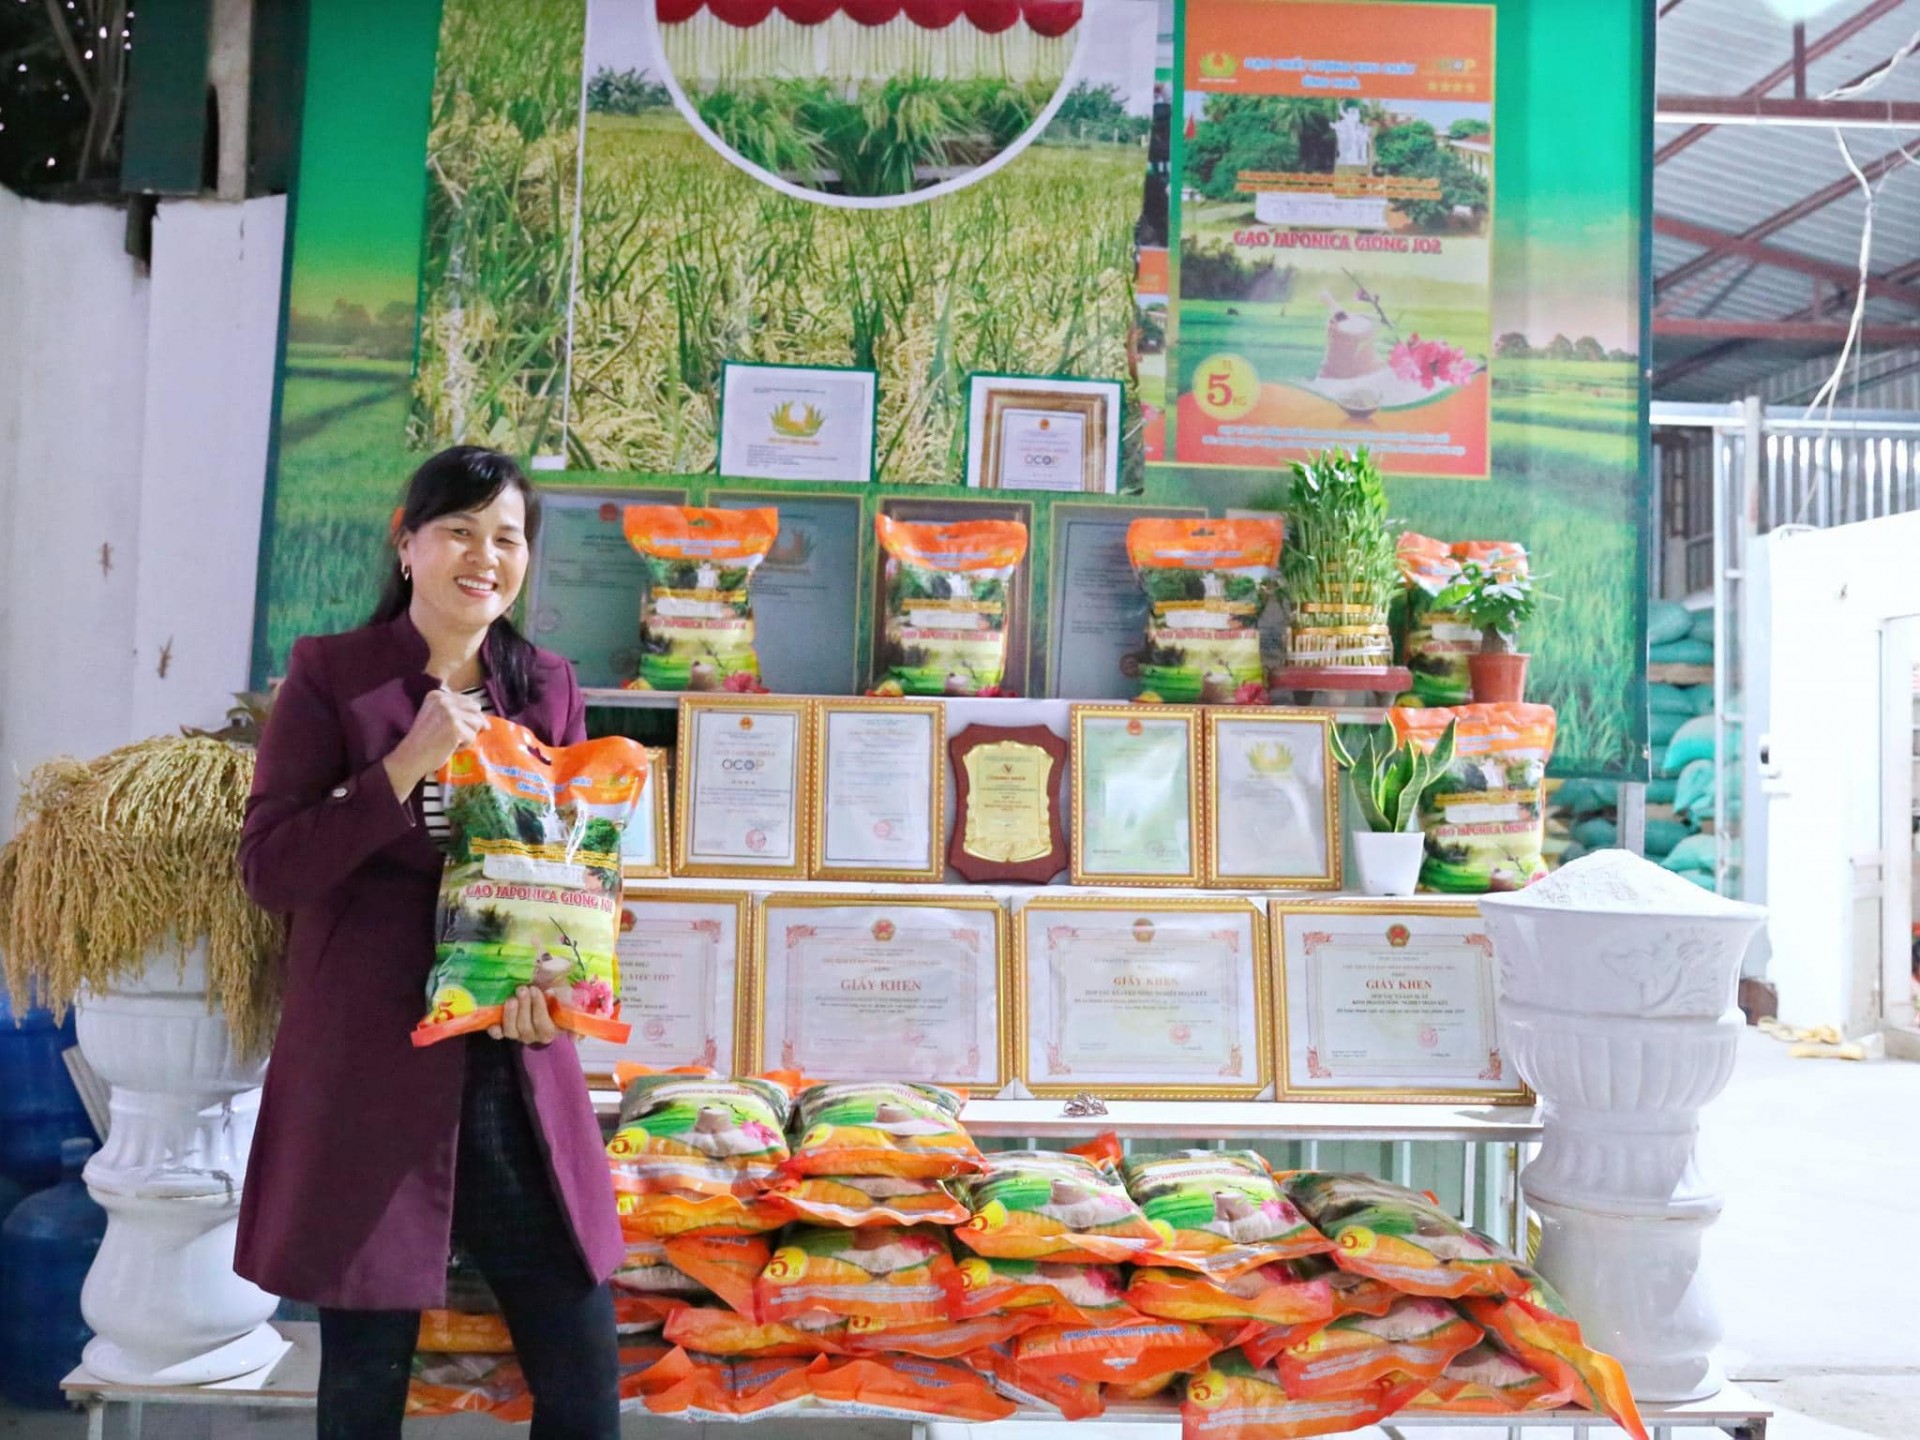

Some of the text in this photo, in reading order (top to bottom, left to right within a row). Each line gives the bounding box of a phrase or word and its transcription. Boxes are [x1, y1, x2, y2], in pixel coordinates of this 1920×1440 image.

[1232, 229, 1270, 249] GẠO
[1273, 231, 1350, 250] JAPONICA
[1207, 373, 1232, 406] 5
[721, 758, 765, 771] OCOP
[465, 883, 492, 900] GẠO
[881, 978, 922, 991] KHEN
[1398, 978, 1433, 990] KHEN
[611, 1134, 631, 1154] 5
[770, 1254, 789, 1277] 5
[1190, 1380, 1212, 1401] 5
